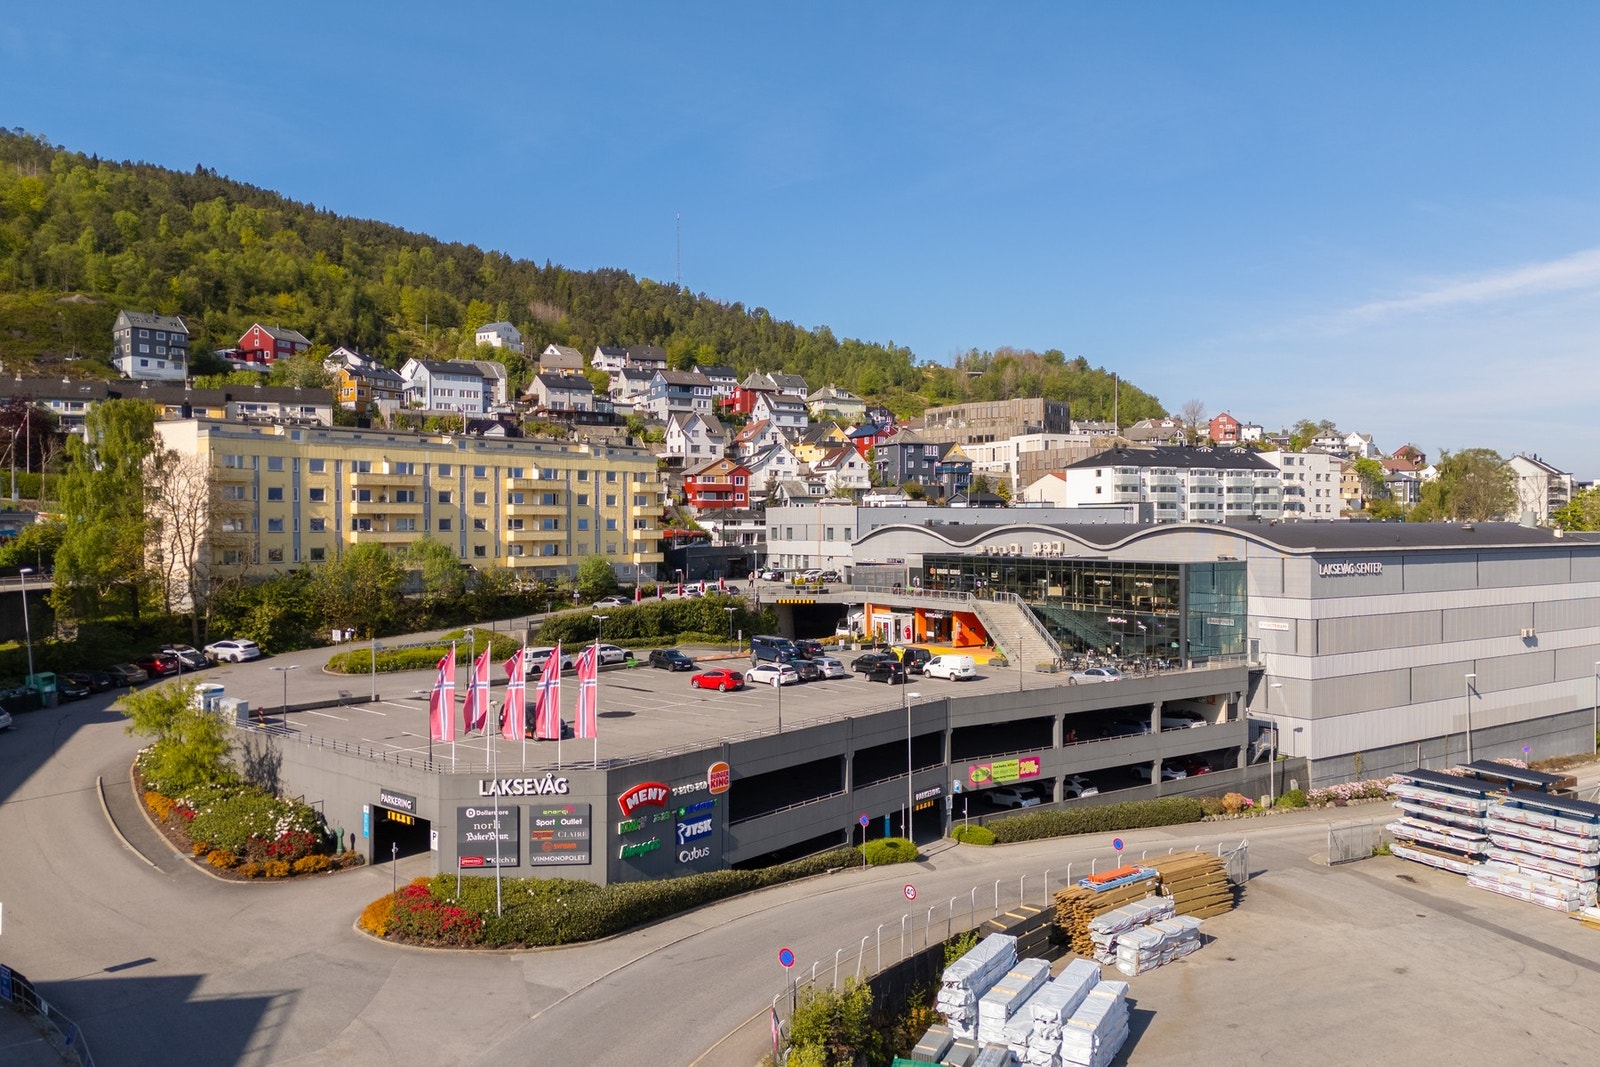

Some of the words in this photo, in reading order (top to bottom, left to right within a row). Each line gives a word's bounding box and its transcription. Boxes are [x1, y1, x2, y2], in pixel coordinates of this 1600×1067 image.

[1319, 560, 1355, 575] LAKSEVÅG
[1356, 563, 1383, 574] SENTER
[711, 770, 729, 779] BURGER
[479, 773, 568, 796] LAKSEVÅG
[711, 777, 729, 789] KING
[381, 793, 412, 810] PARKERING
[626, 787, 667, 810] MENY
[474, 820, 501, 829] norli
[536, 819, 555, 827] Sport
[685, 819, 712, 837] JYSK
[466, 832, 509, 841] BakerBun
[679, 847, 709, 862] Cubus
